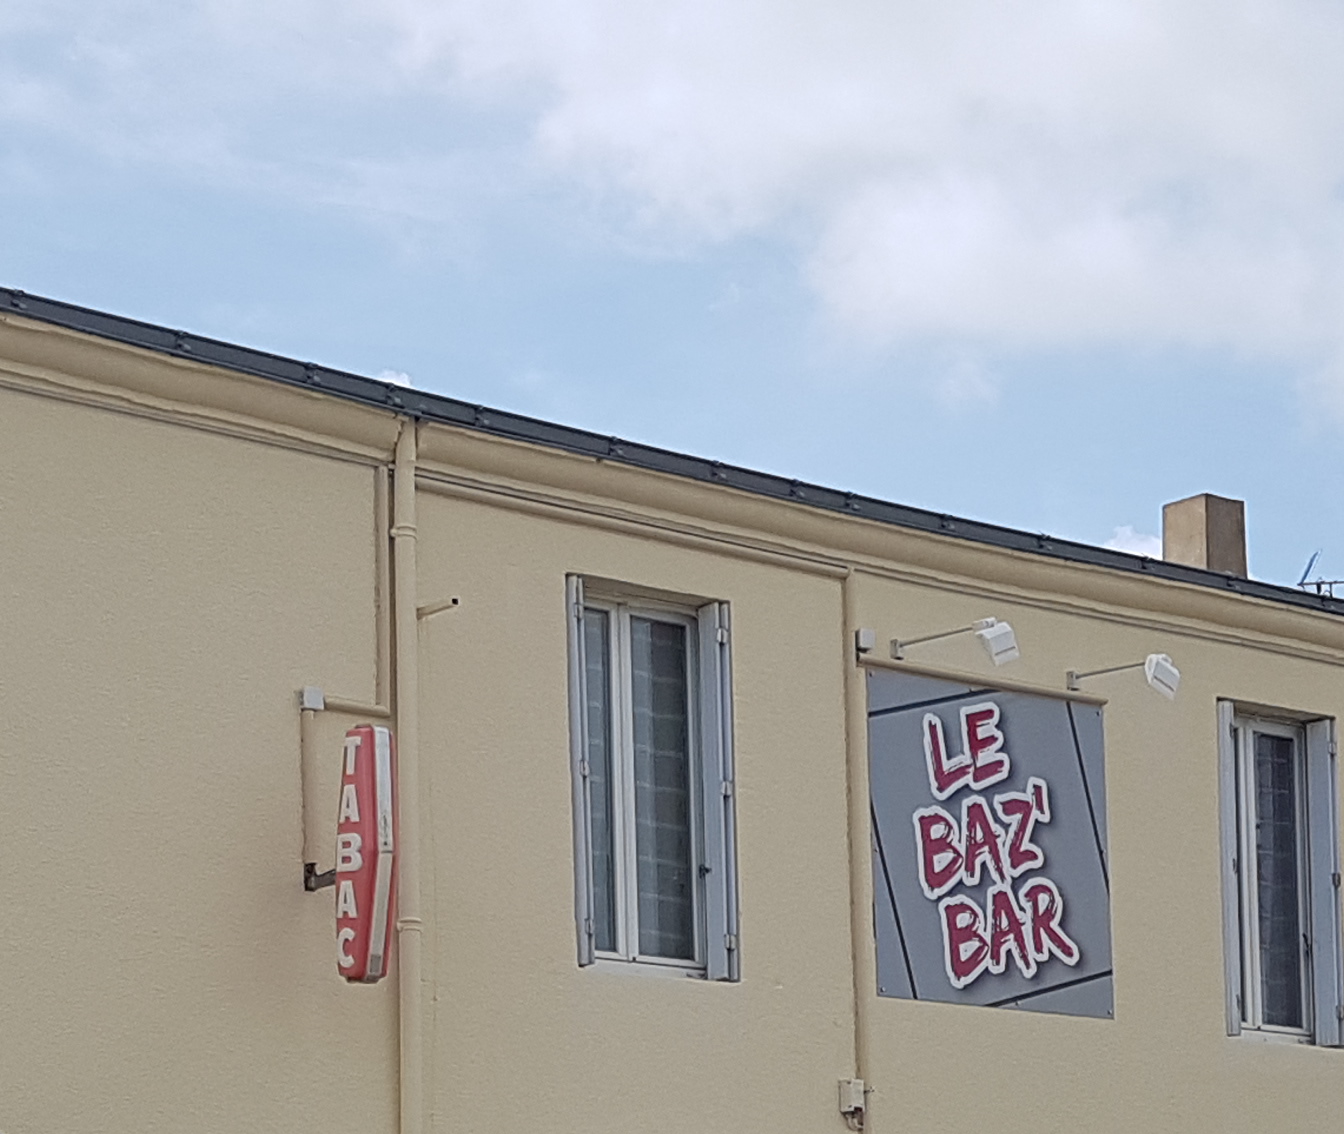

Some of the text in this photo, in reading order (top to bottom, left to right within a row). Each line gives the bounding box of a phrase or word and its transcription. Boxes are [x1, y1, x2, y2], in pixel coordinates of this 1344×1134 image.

[924, 702, 1009, 799] LE
[336, 736, 363, 968] TABAC
[915, 778, 1049, 899] BAZ'
[940, 878, 1079, 988] BAR
